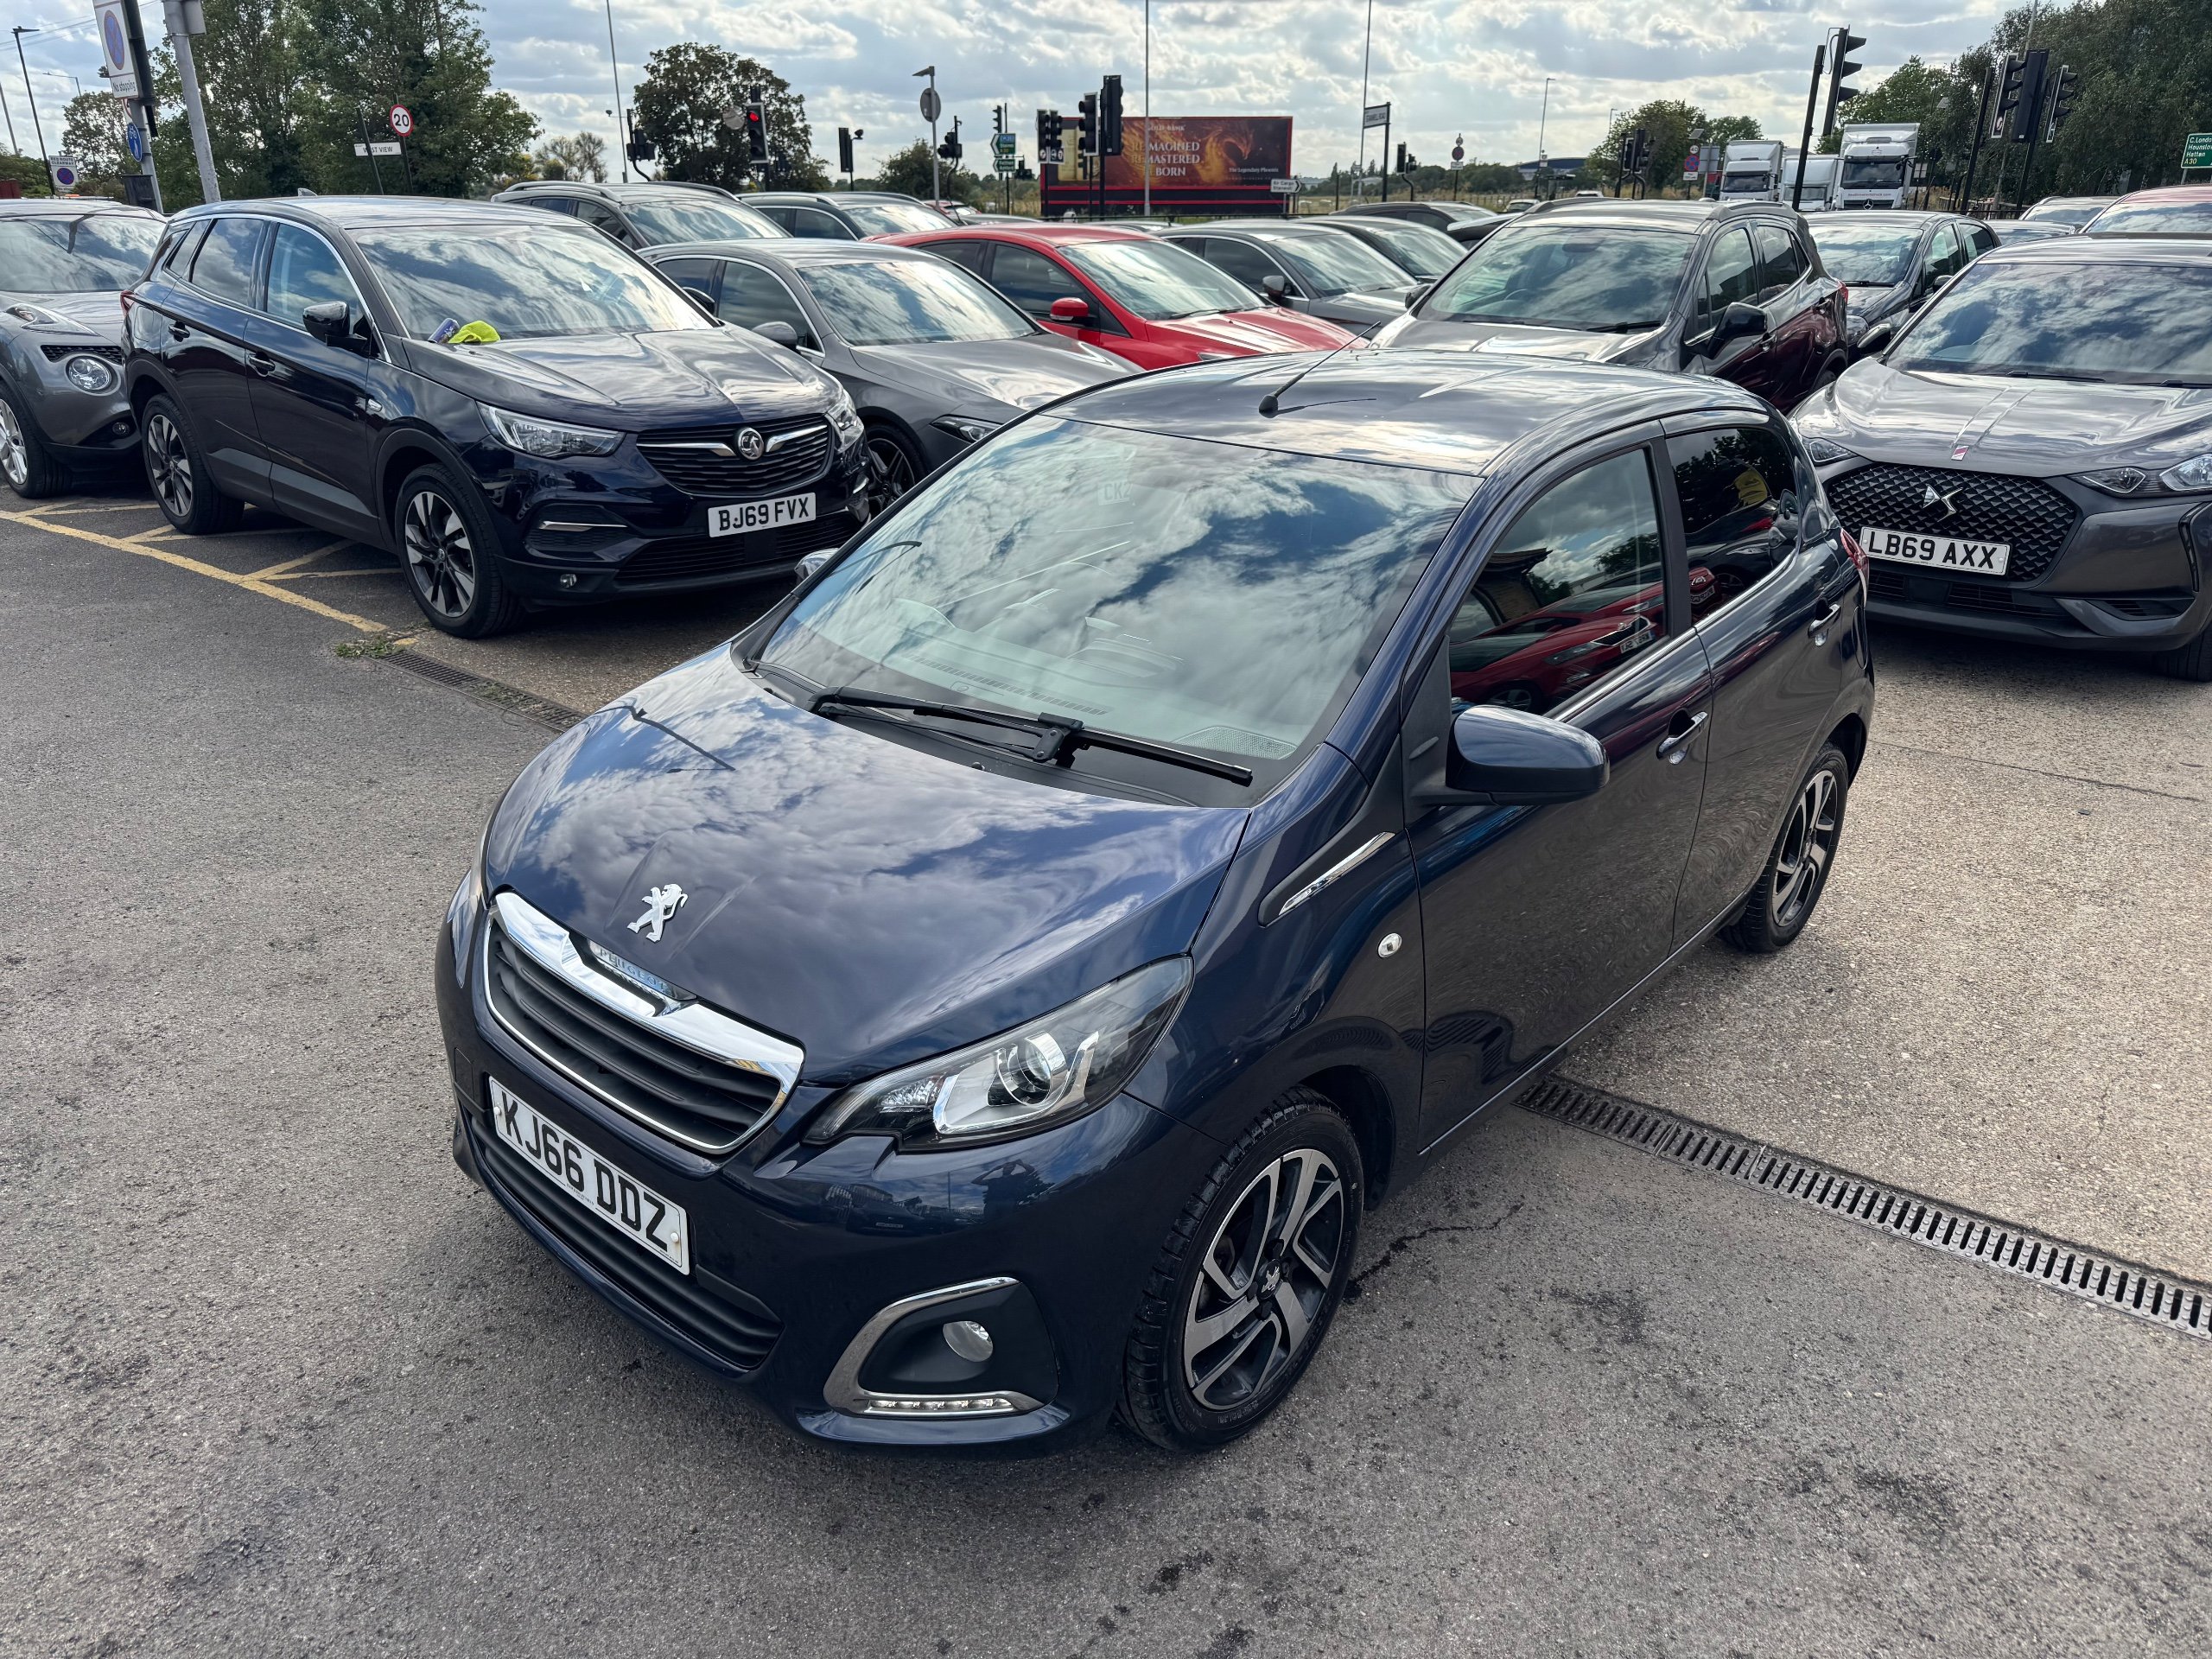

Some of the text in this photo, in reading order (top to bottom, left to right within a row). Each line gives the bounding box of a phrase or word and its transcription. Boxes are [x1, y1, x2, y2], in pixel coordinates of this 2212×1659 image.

[119, 80, 136, 92] stopping
[394, 114, 410, 127] 20
[718, 497, 809, 531] BJ69 FVX
[1868, 531, 1997, 569] LB69 AXX
[599, 947, 669, 994] PEUGEOT
[501, 1090, 668, 1252] KJ66 DDZ
